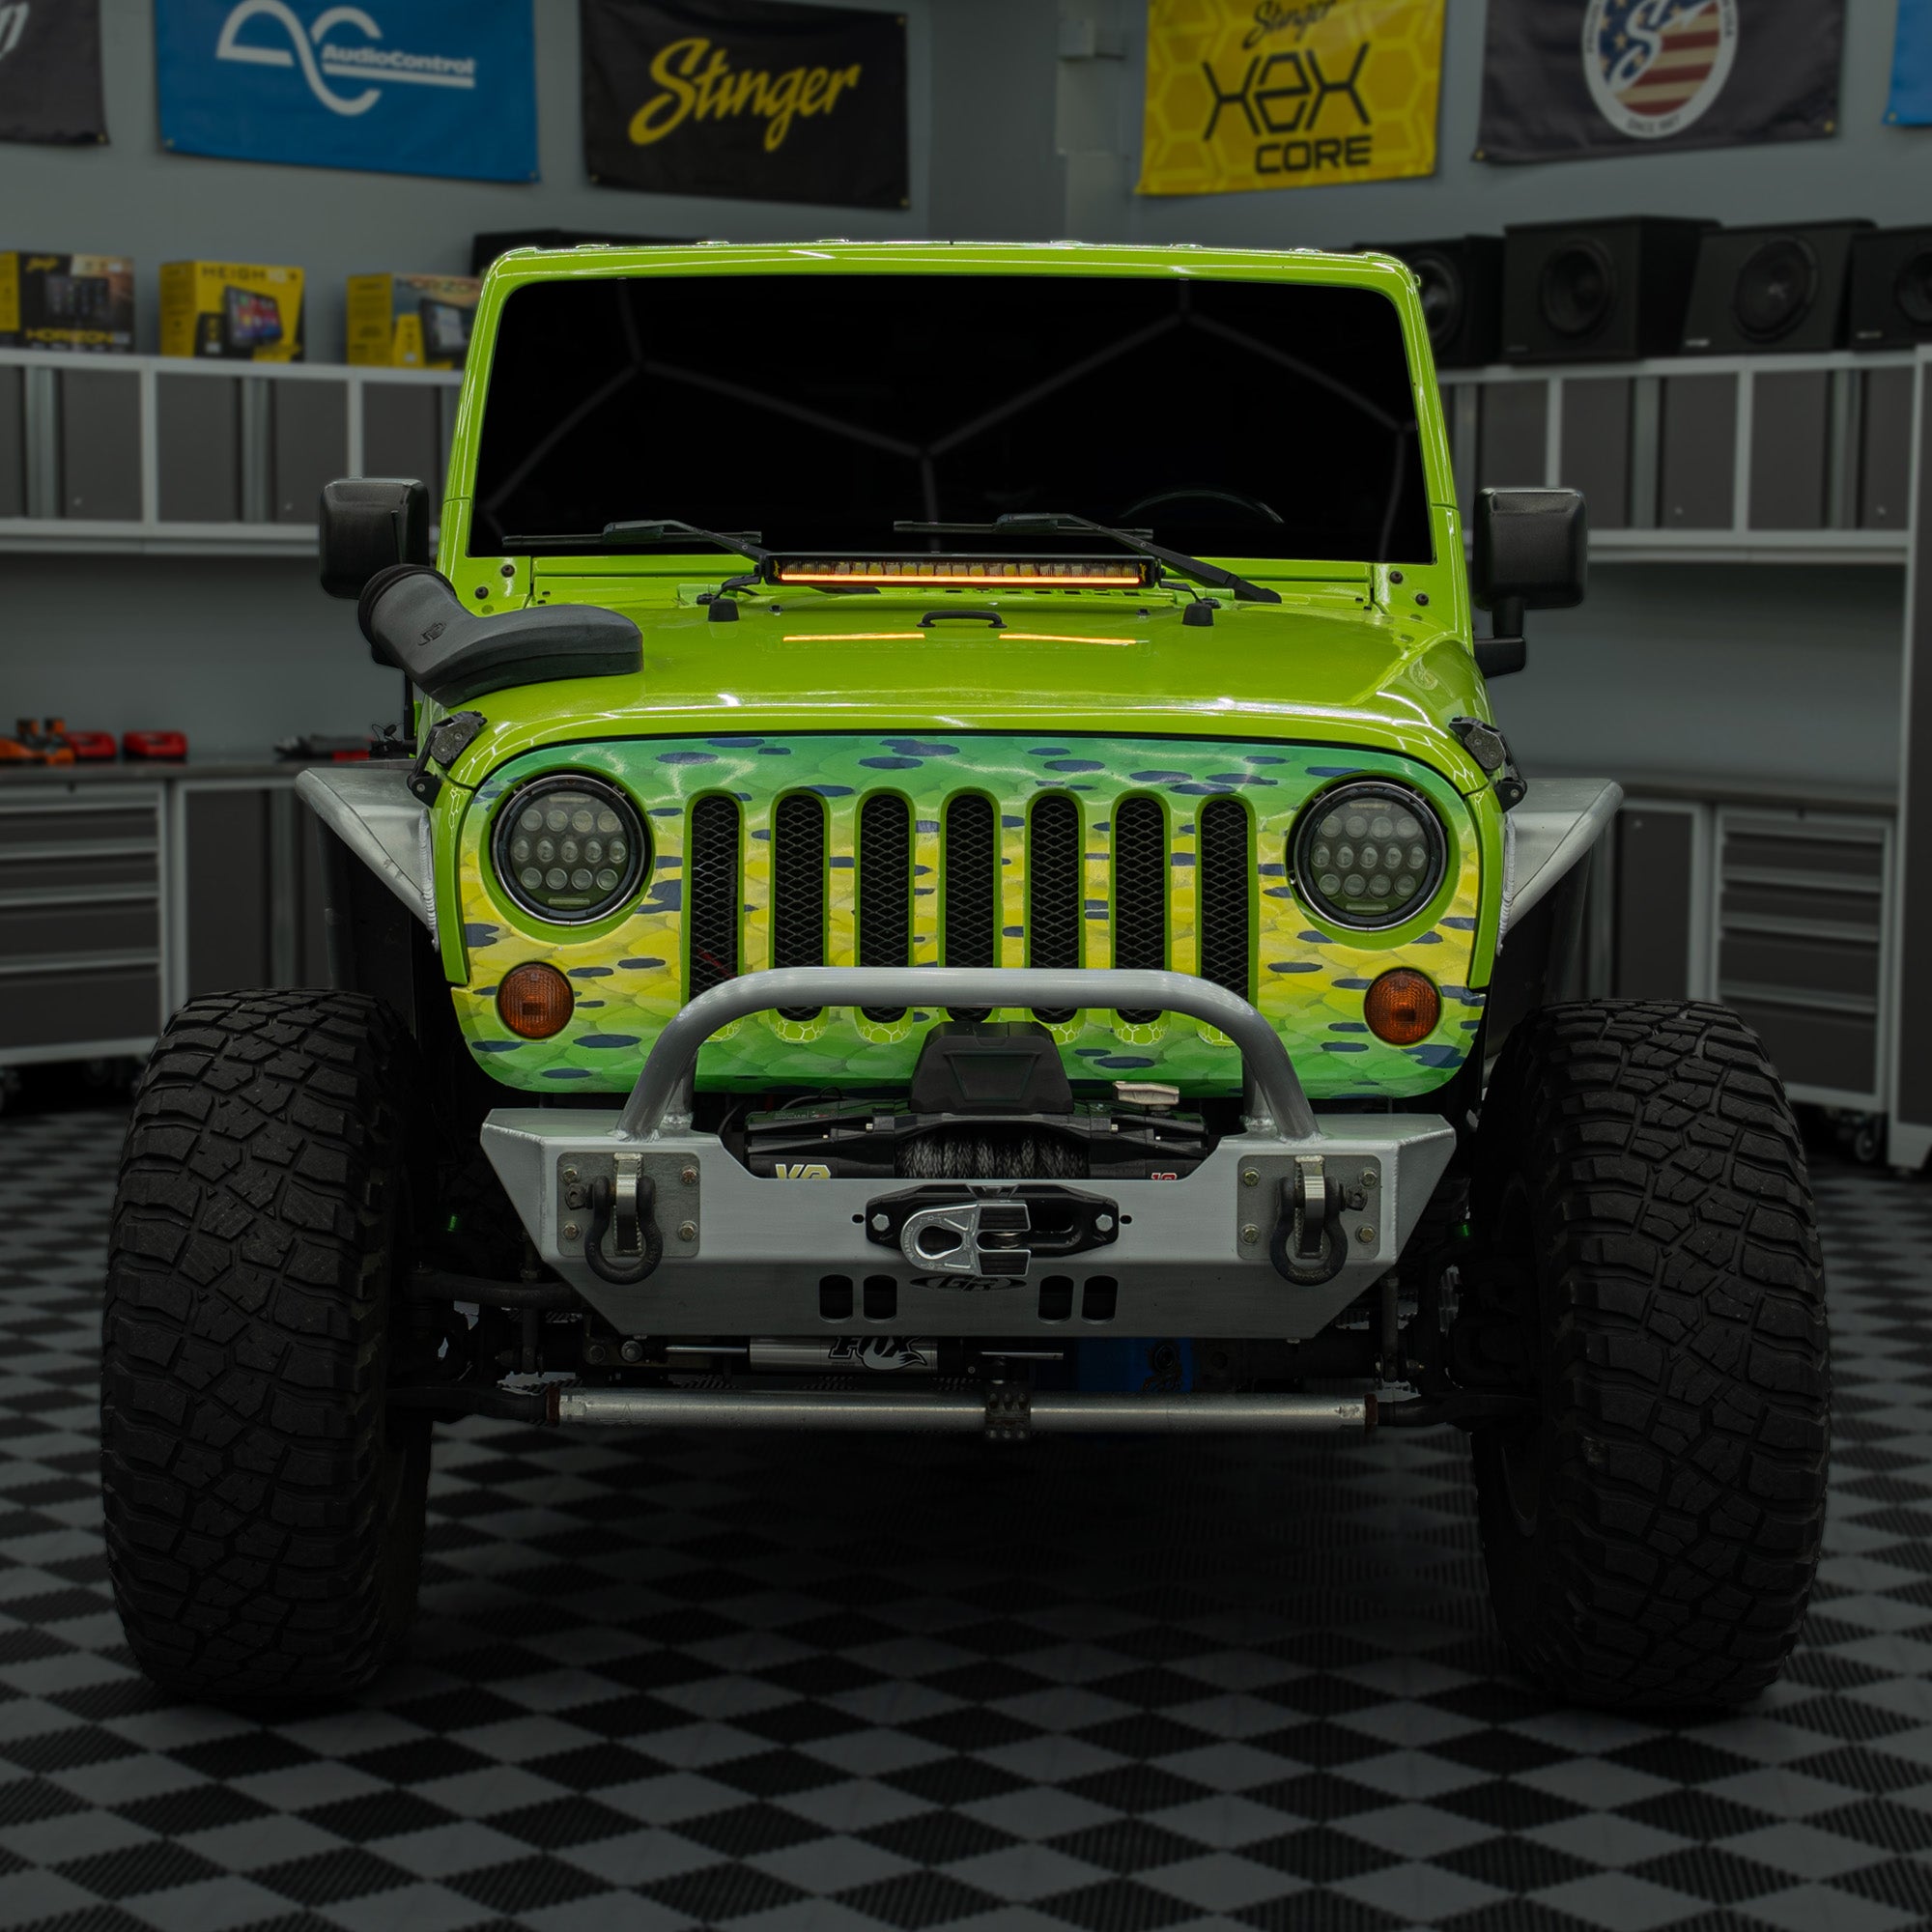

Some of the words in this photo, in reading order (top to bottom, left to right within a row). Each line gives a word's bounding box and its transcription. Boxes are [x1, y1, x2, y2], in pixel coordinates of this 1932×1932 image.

[322, 43, 476, 76] AudioControl
[628, 37, 863, 153] Stinger
[1255, 134, 1373, 176] CORE
[829, 1336, 920, 1366] FOX
